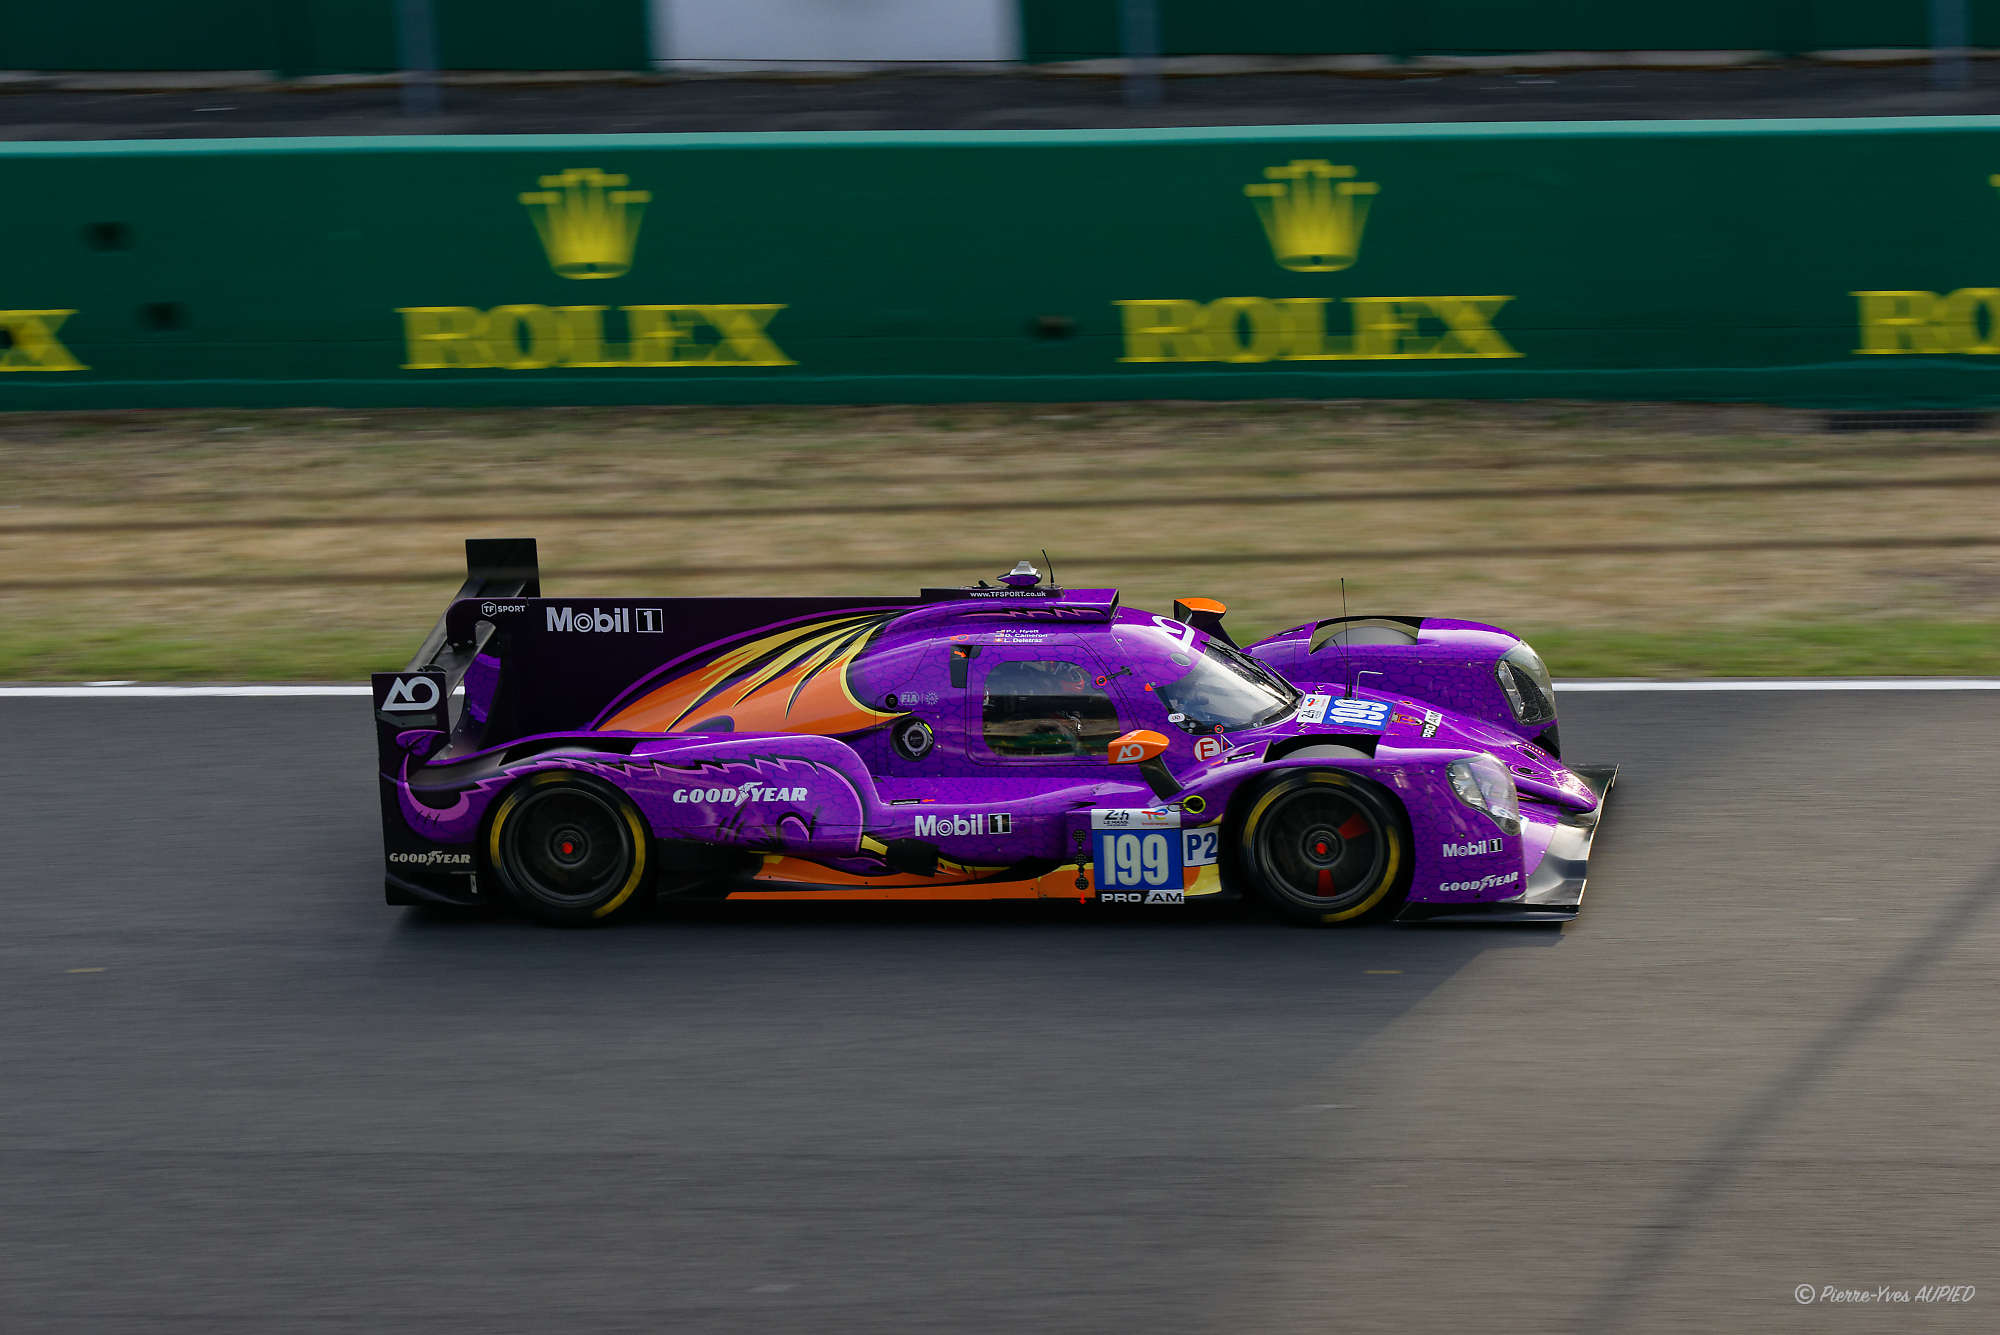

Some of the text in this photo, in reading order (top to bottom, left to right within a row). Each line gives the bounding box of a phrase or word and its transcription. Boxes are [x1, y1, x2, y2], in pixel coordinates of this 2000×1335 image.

[394, 303, 799, 370] ROLEX
[1112, 295, 1527, 363] ROLEX
[498, 605, 526, 613] SPORT
[546, 607, 630, 633] Mobil
[1329, 698, 1388, 726] 199
[915, 814, 983, 837] Mobil
[1102, 833, 1169, 885] 199
[1186, 831, 1217, 861] P2
[1442, 840, 1487, 857] Mobil
[1101, 893, 1183, 903] PRO AM
